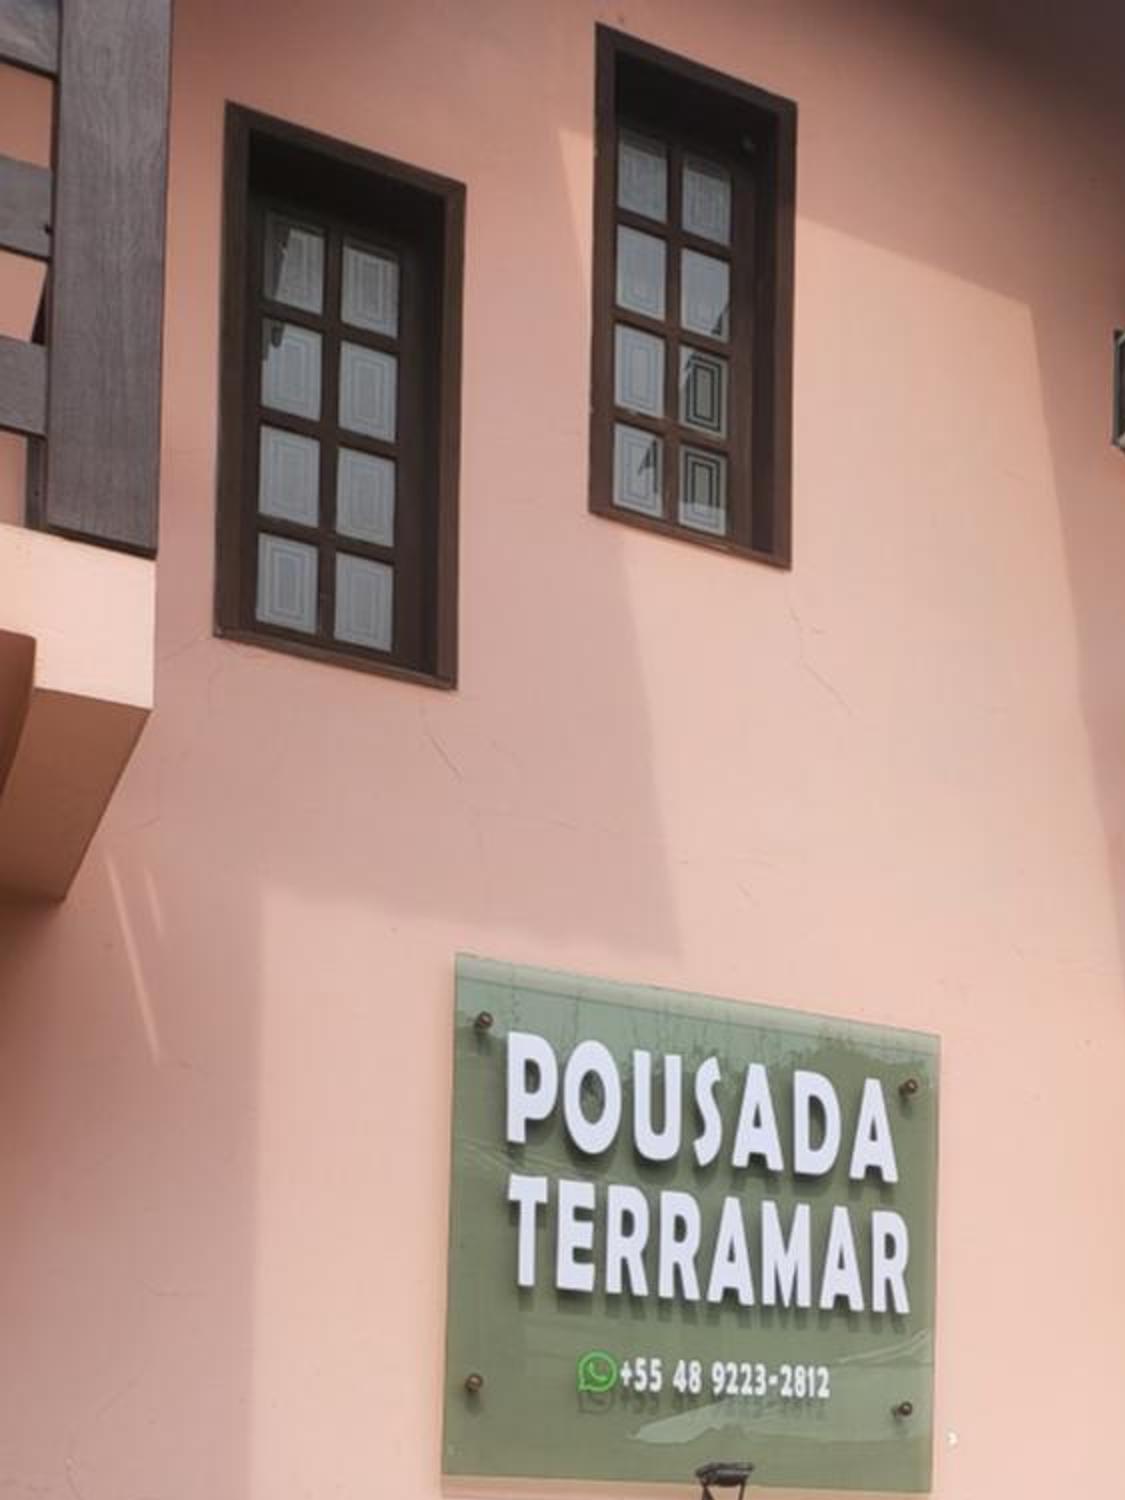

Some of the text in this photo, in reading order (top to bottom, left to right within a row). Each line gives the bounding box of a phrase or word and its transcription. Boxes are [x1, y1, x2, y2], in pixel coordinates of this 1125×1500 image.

[506, 1030, 899, 1184] POUSADA
[507, 1173, 910, 1315] TERRAMAR
[620, 1356, 831, 1398] +55 48 9223-2812
